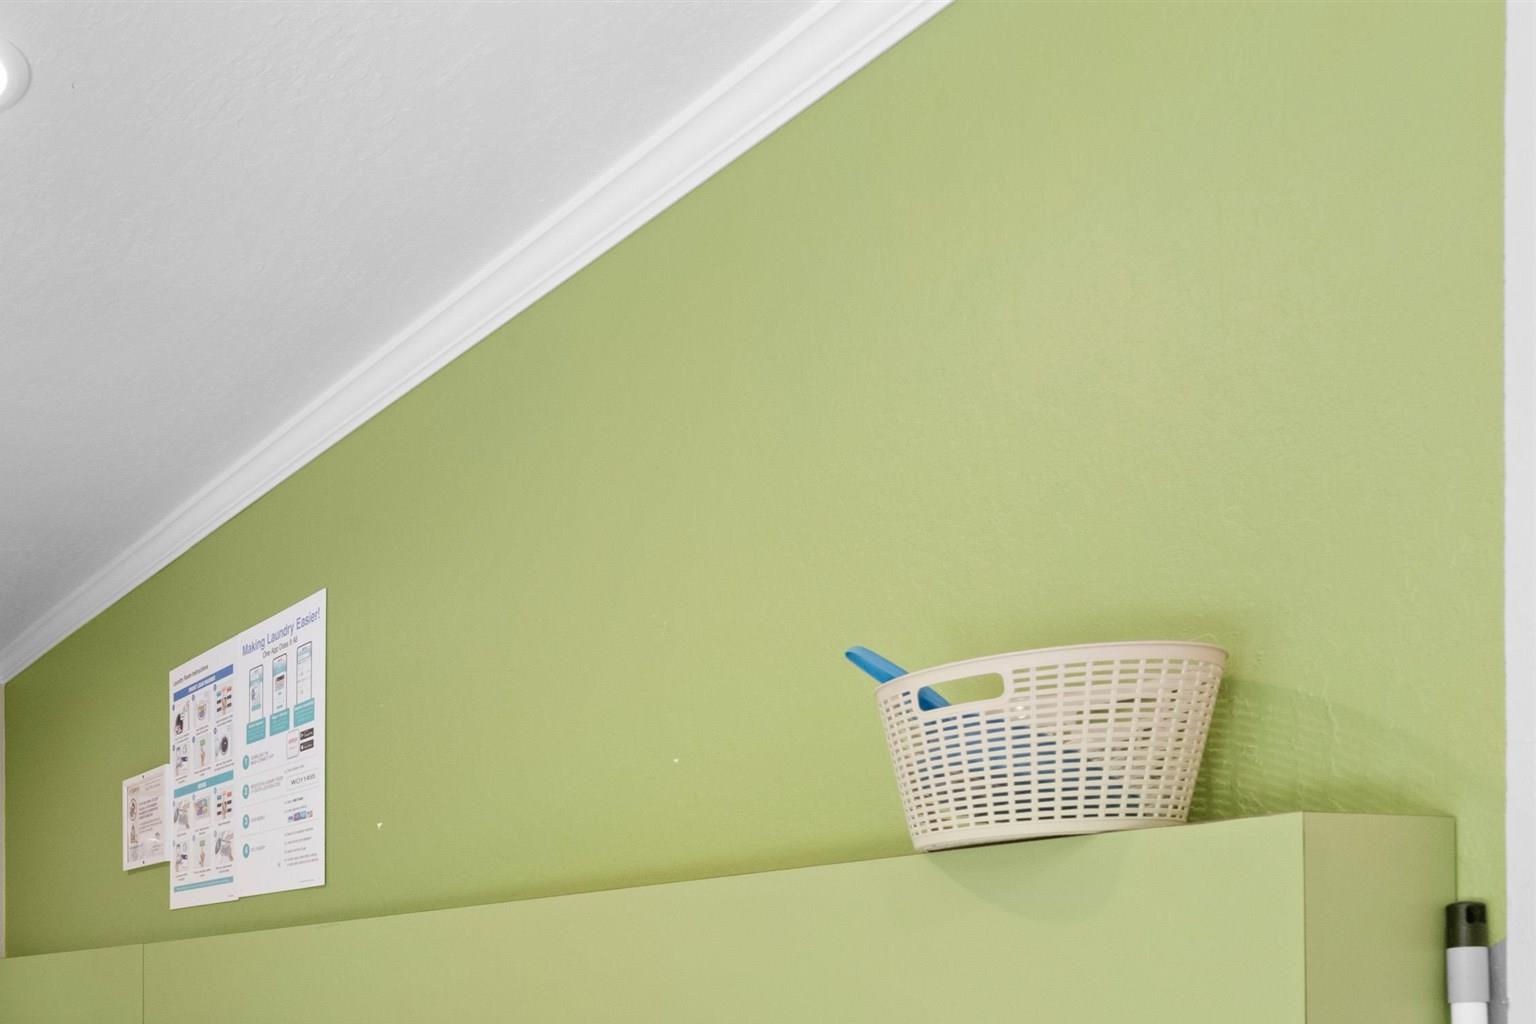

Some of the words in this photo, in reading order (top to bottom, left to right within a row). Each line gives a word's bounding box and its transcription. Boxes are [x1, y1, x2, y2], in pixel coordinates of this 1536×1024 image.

[242, 637, 266, 656] Making
[267, 623, 295, 645] Laundry
[296, 607, 321, 630] Easier!
